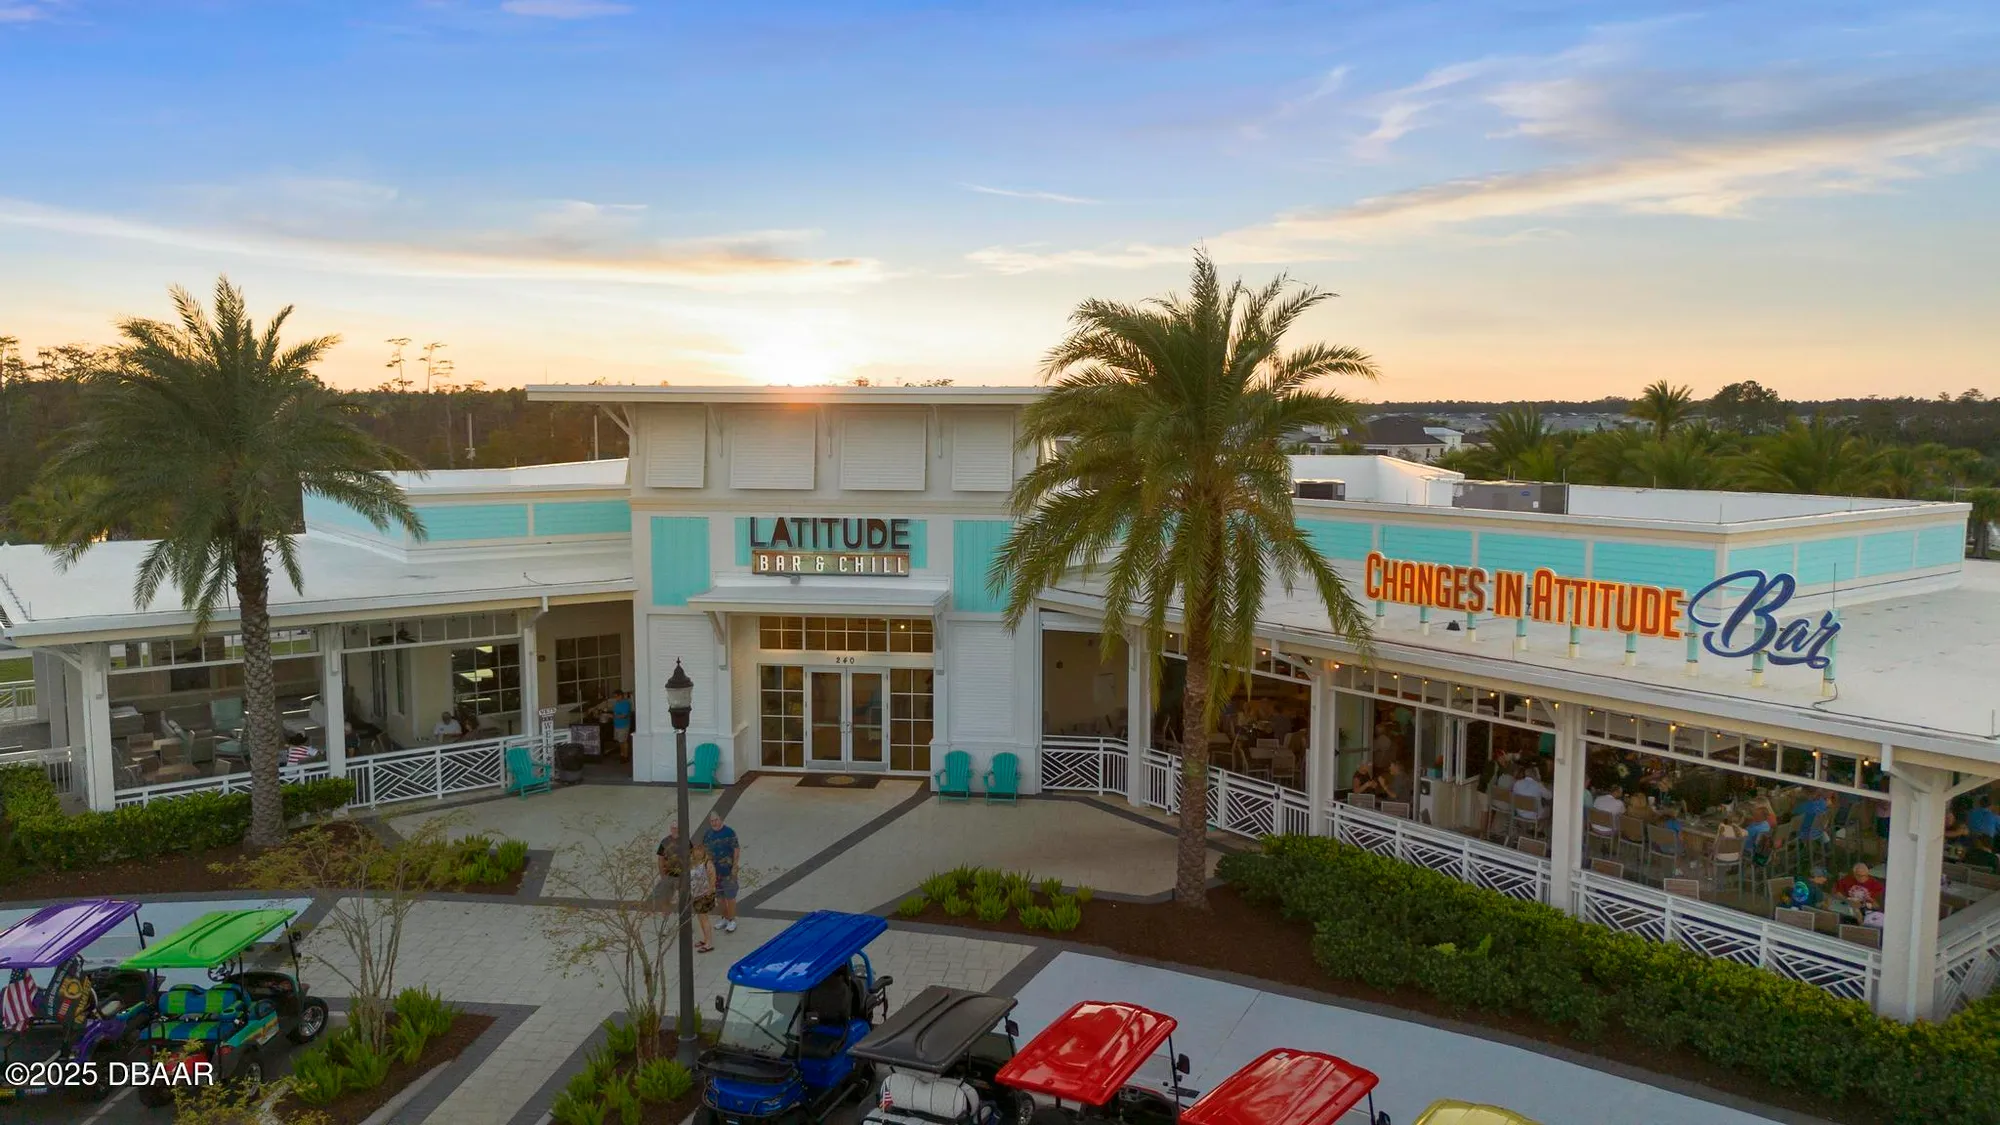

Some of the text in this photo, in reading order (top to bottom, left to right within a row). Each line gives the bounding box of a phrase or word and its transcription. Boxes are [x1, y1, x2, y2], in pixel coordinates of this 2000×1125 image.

[750, 517, 910, 549] LATITUDE
[760, 555, 905, 573] BAR & CHILL
[1365, 551, 1841, 669] CHANGES IN ATTITUDE Bar
